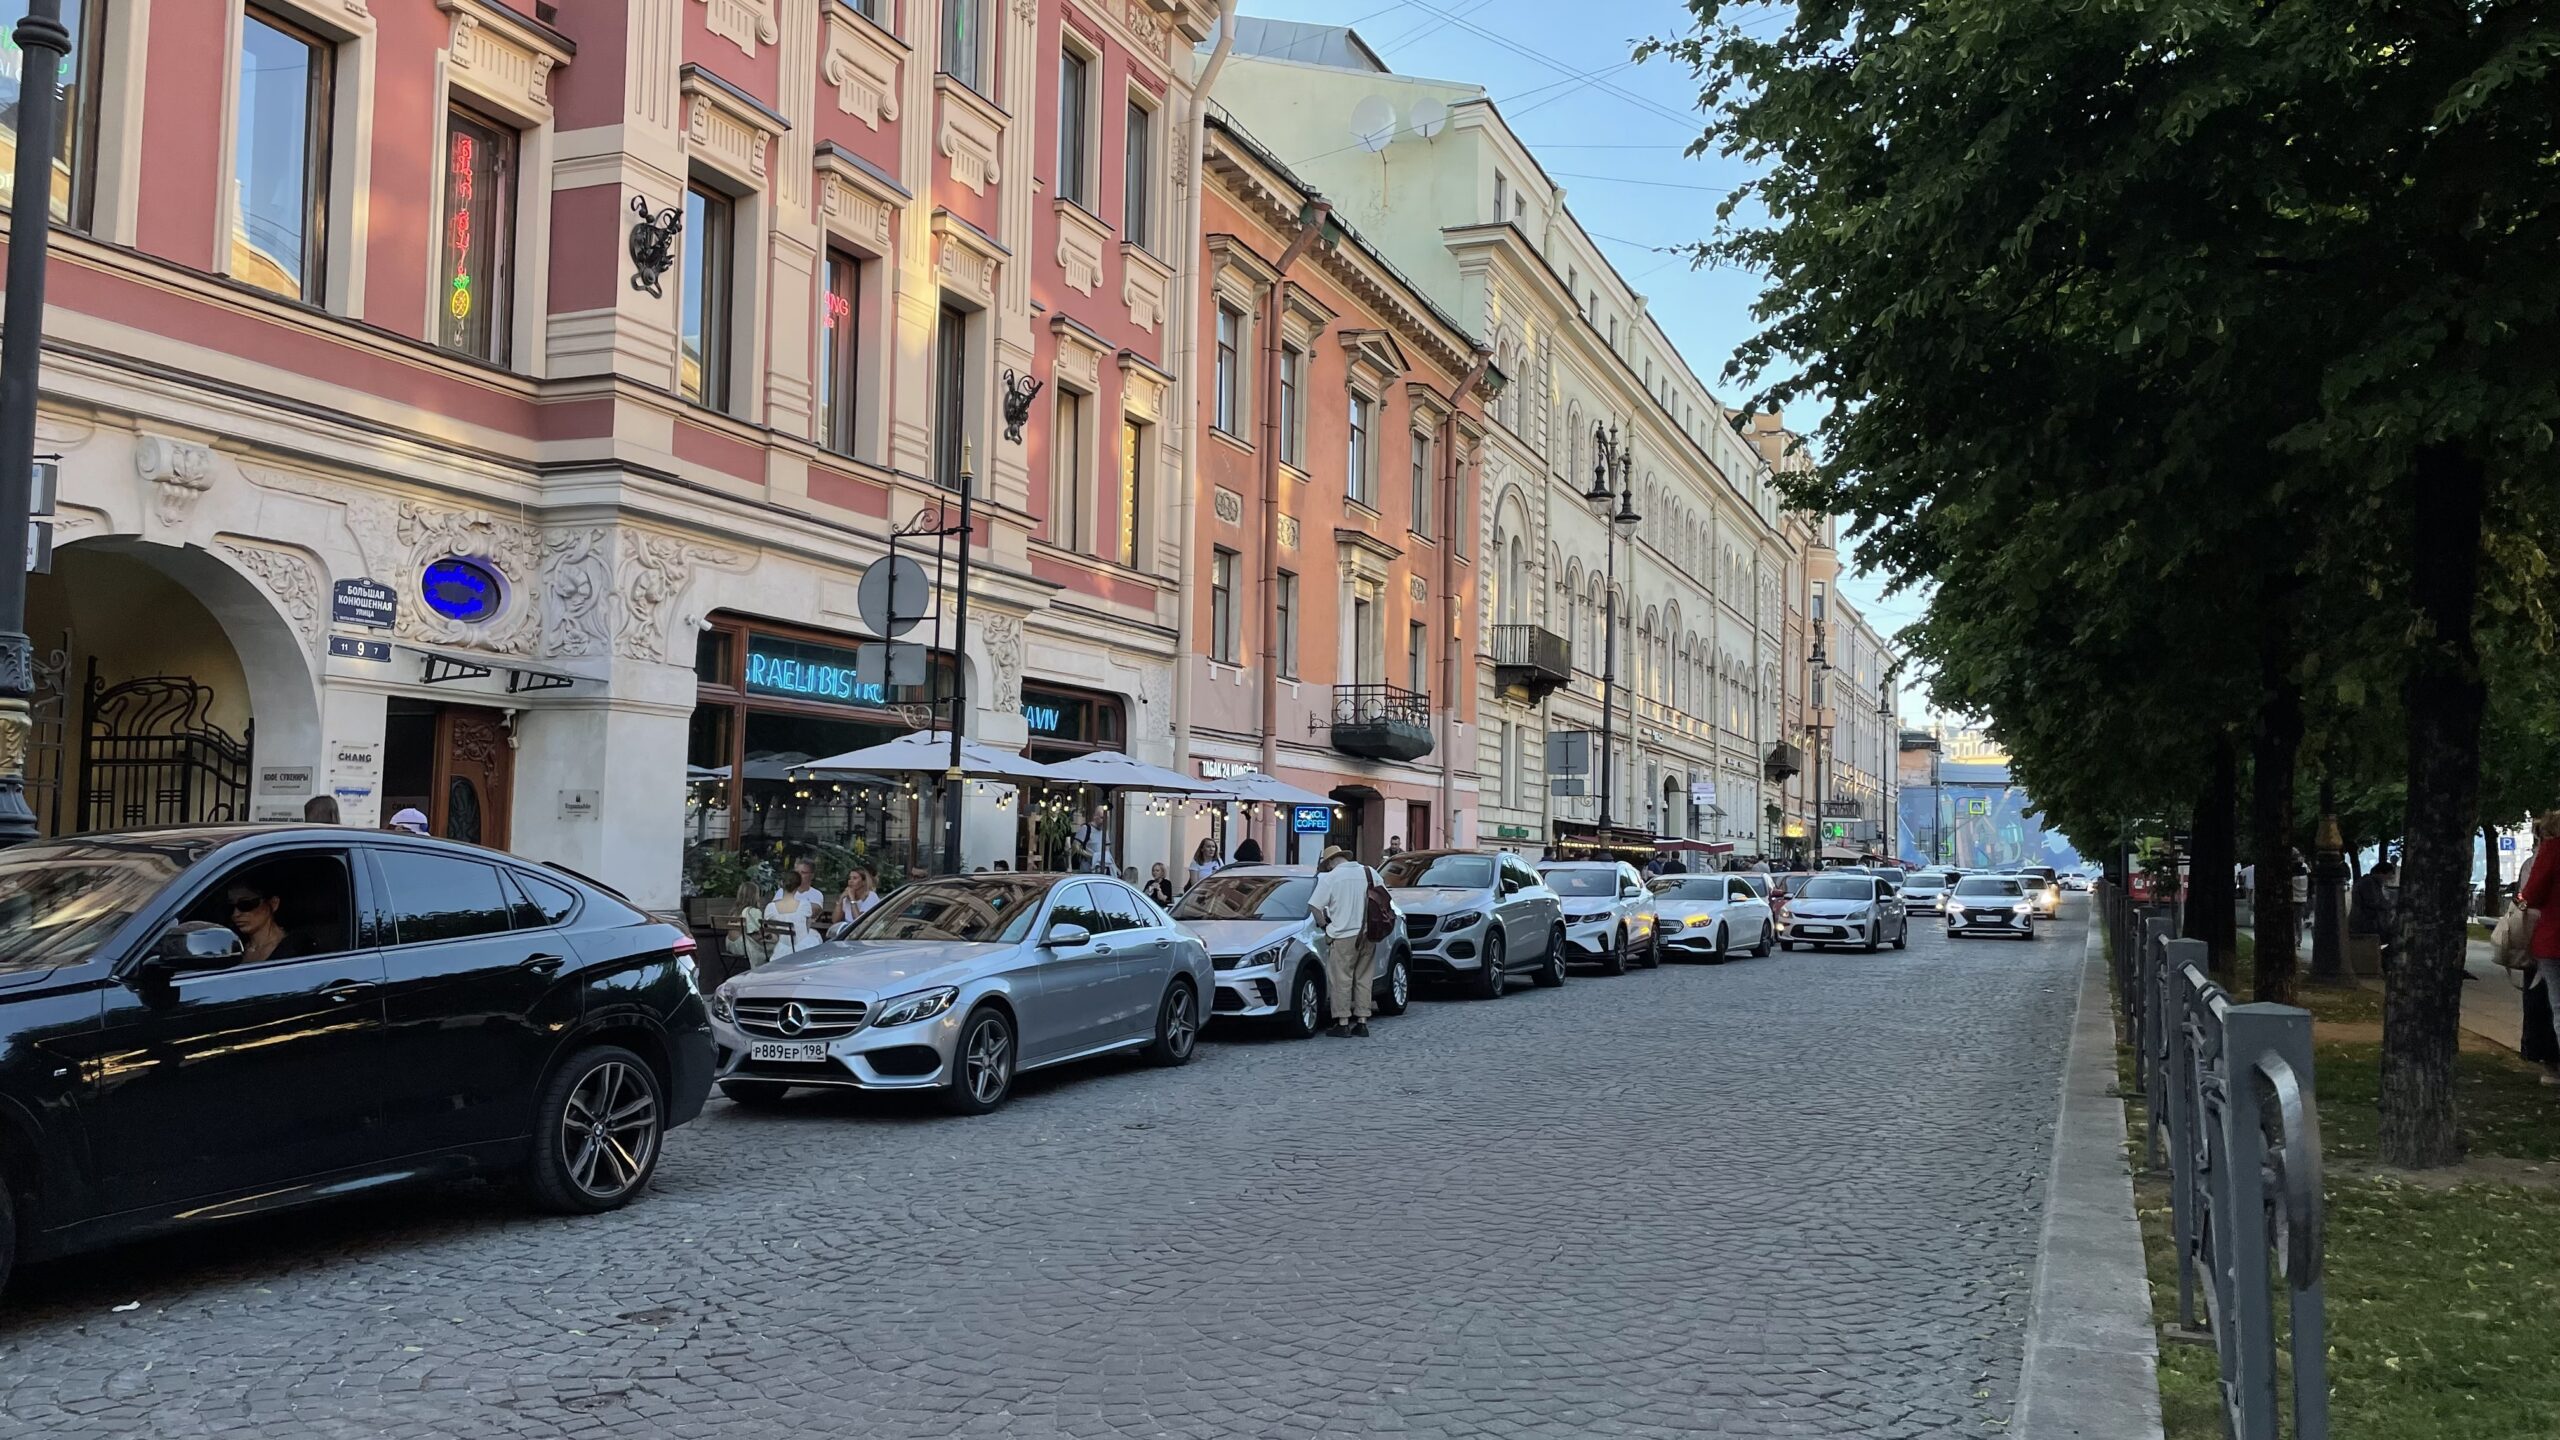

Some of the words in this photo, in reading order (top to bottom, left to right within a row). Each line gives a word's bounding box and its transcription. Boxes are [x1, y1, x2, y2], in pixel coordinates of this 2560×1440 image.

[347, 585, 385, 600] БОЛЬШАЯ
[338, 594, 393, 612] КОНЮШЕННАЯ
[355, 608, 375, 618] УЛИЦА
[341, 643, 348, 652] 11
[357, 642, 365, 656] 9
[374, 647, 379, 655] 7
[338, 753, 372, 763] CHANG
[1202, 760, 1222, 778] ТАБАК
[1222, 763, 1231, 779] 24
[1296, 819, 1328, 828] COFFEE
[803, 1044, 821, 1056] 198
